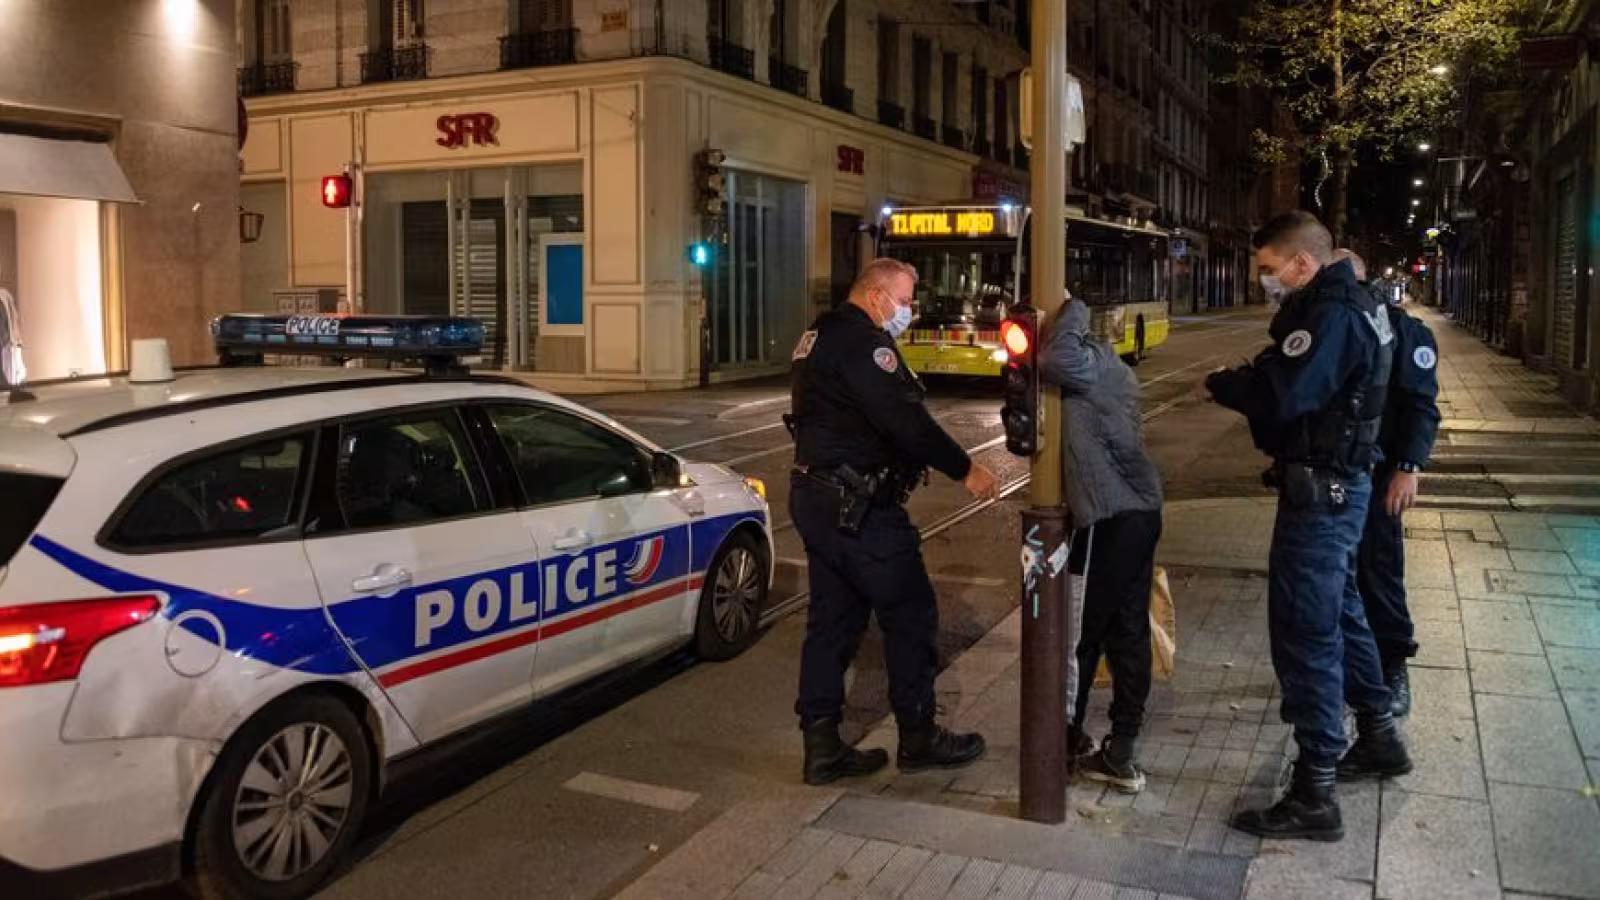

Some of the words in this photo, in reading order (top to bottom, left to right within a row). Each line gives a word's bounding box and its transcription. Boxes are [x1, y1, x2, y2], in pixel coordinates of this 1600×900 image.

[436, 112, 498, 148] SFR
[837, 145, 864, 175] SFR
[957, 213, 993, 232] NORD
[287, 316, 339, 335] POLICE
[415, 549, 616, 647] POLICE
